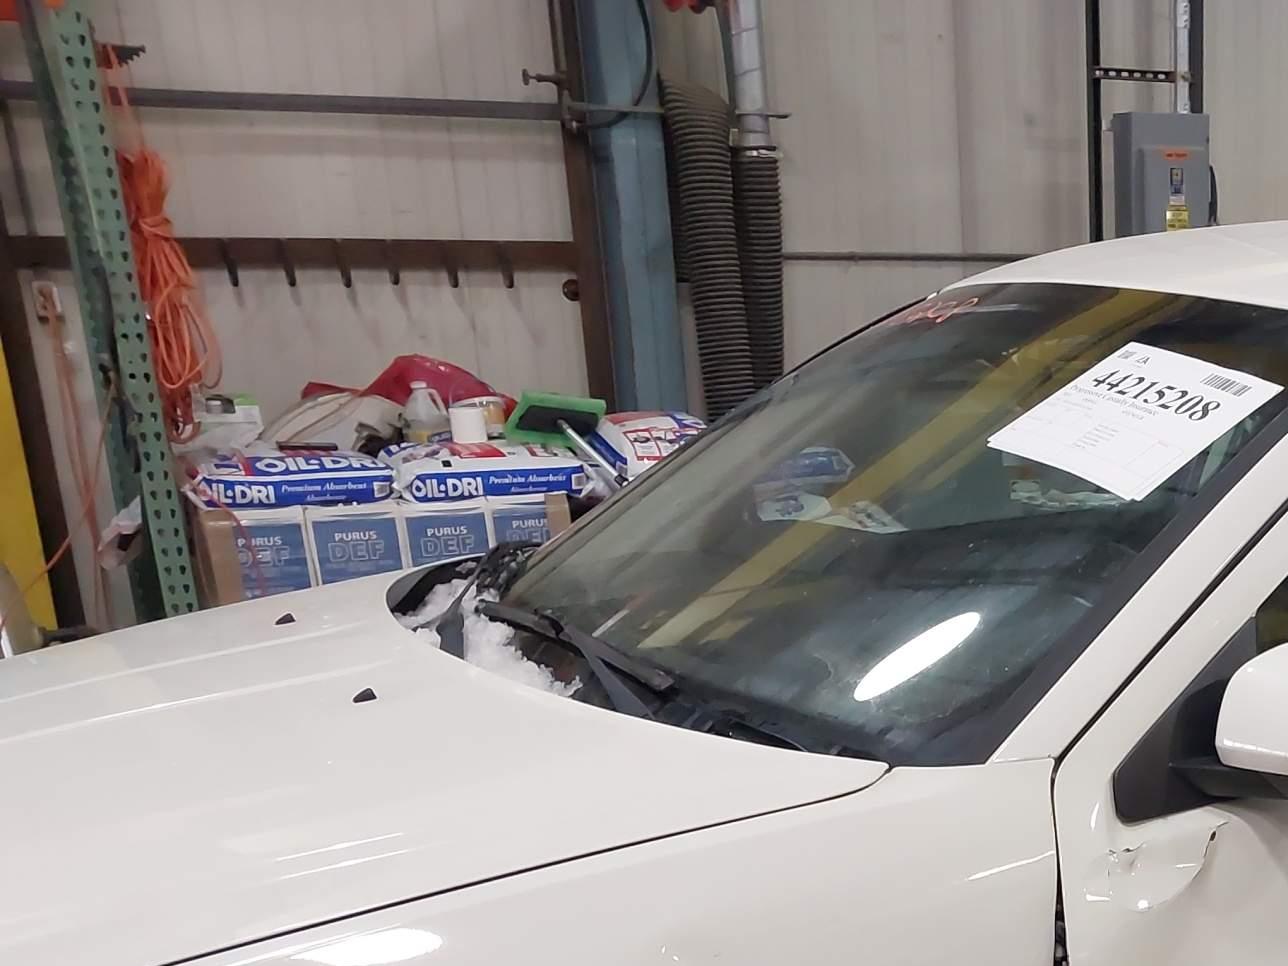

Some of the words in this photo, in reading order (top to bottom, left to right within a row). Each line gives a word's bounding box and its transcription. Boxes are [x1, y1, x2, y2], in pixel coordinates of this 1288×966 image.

[1092, 369, 1221, 422] 44215208
[334, 530, 378, 542] PURUS
[426, 525, 468, 537] PURUS
[328, 540, 385, 562] DEF
[421, 534, 475, 557] DEF
